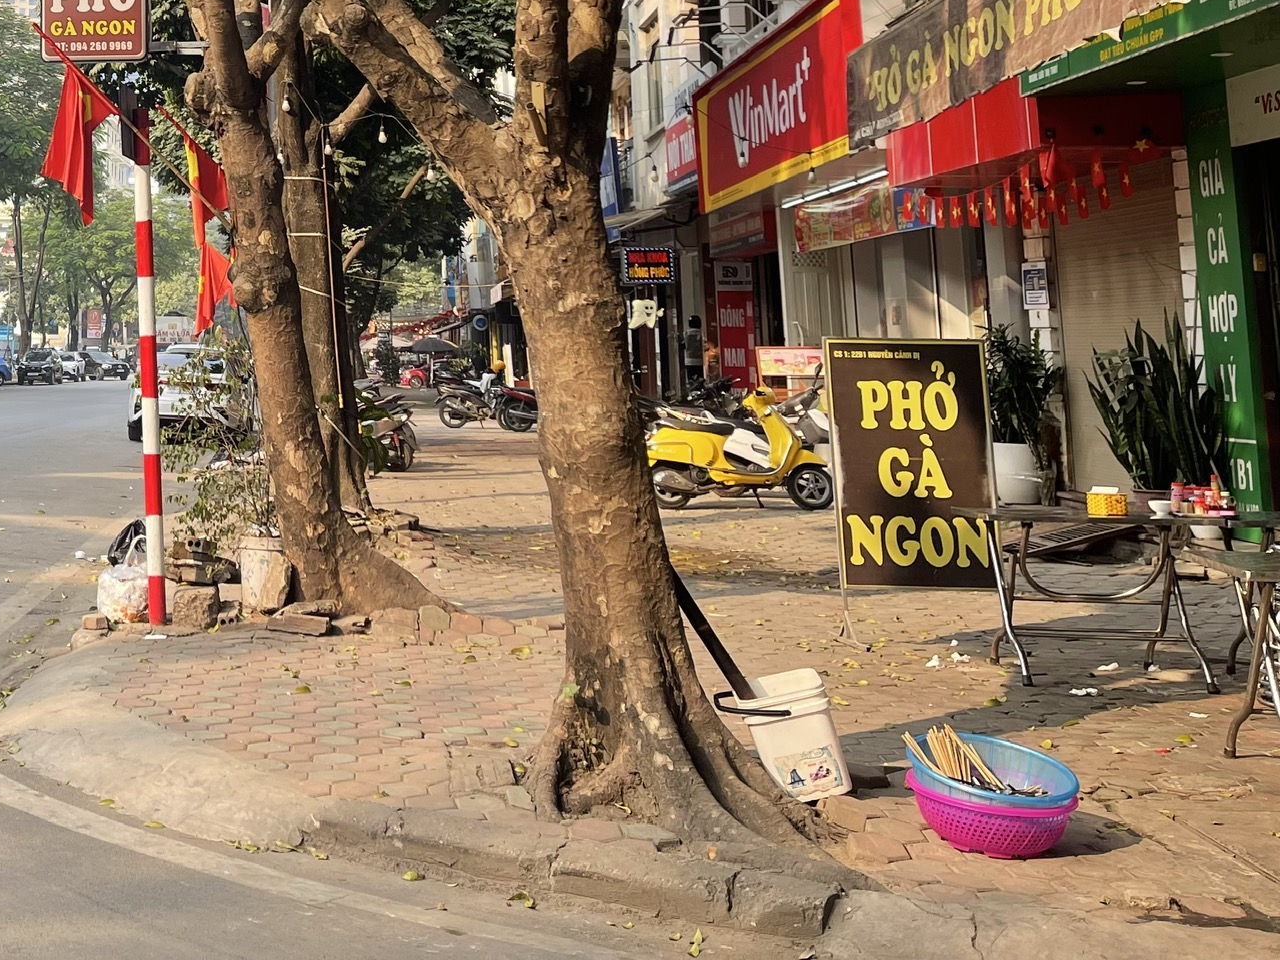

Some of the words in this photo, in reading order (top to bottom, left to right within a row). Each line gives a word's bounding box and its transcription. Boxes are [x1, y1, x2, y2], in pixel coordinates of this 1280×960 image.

[50, 16, 78, 36] GÀ
[81, 20, 136, 36] NGON
[70, 41, 88, 51] 094
[90, 41, 107, 51] 260
[109, 41, 133, 51] 9969
[906, 29, 938, 95] GÀ
[1198, 149, 1225, 198] GIÁ
[1207, 212, 1229, 266] CẢ
[1208, 289, 1238, 342] HỢP
[724, 348, 746, 367] NAM
[833, 350, 843, 359] CS
[1220, 355, 1237, 403] LÝ
[856, 360, 959, 431] PHỞ
[878, 433, 953, 499] GÀ
[846, 514, 990, 569] NGON
